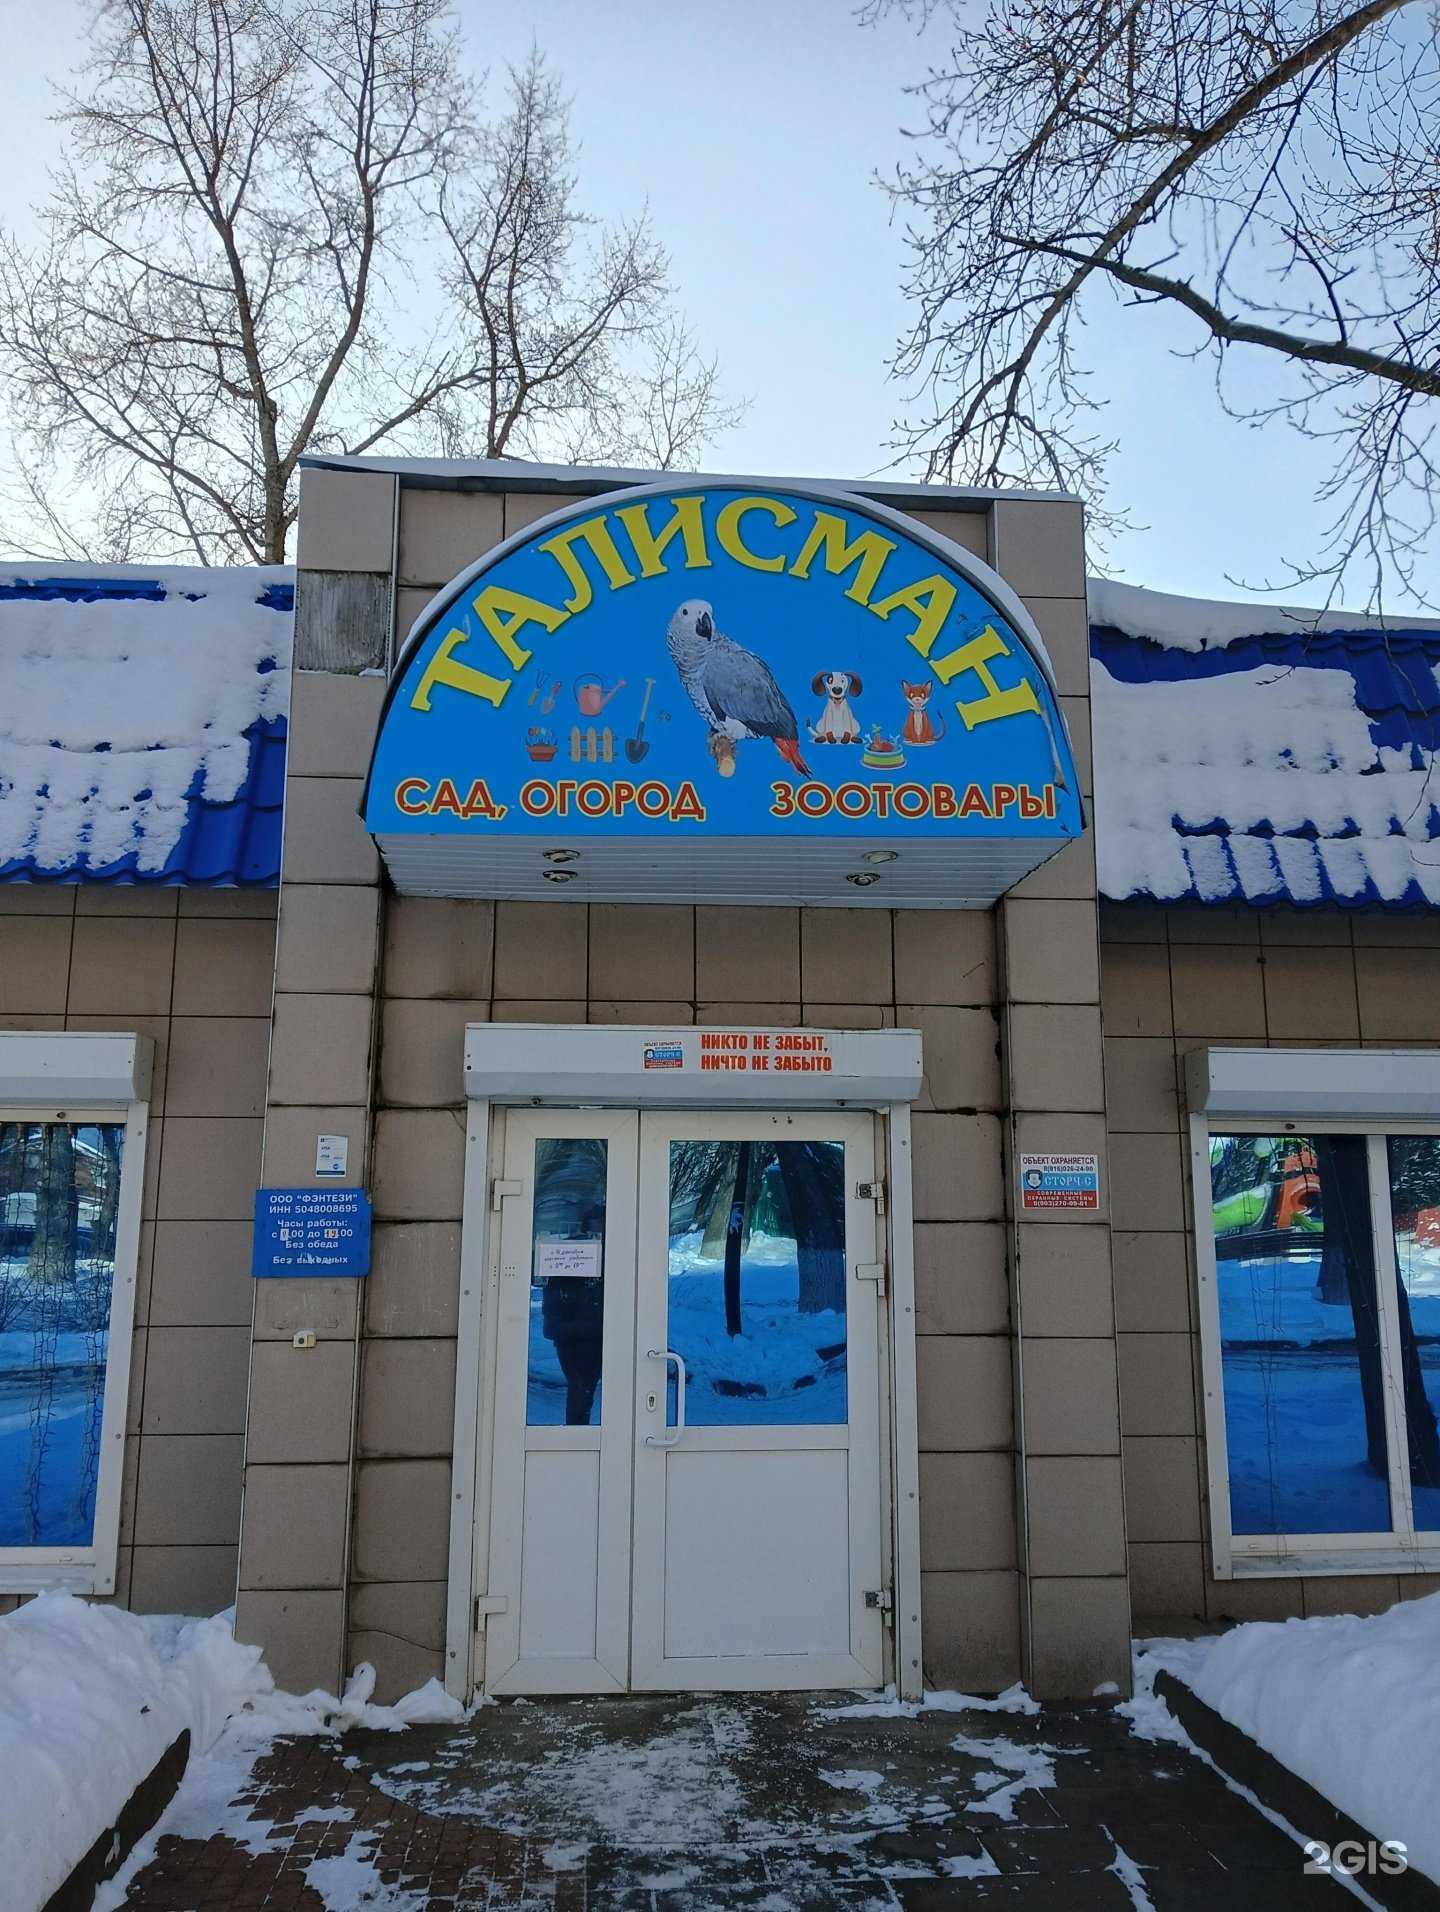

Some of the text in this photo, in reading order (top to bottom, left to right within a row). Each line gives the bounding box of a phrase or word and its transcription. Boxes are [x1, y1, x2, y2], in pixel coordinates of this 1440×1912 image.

[410, 496, 1041, 732] ТАЛИСМАН
[395, 779, 705, 820] САД, ОГОРОД
[771, 781, 1056, 819] ЗООТОВАРЫ
[701, 1034, 748, 1050] НИКТО
[753, 1035, 770, 1050] НЕ
[775, 1035, 829, 1053] ЗАБЫТ,
[701, 1055, 747, 1070] НИЧТО
[752, 1055, 769, 1071] НЕ
[774, 1055, 832, 1072] ЗАБЫТО
[1022, 1156, 1095, 1164] ОБЪЕКТ ОХРАНЯЕТСЯ
[270, 1193, 358, 1204] ООО "ФЭНТЕЗИ"
[269, 1204, 358, 1214] ИНН 5048008695
[277, 1218, 348, 1230] Часы работы:
[307, 1231, 321, 1239] до
[285, 1239, 339, 1249] Без обеда
[273, 1255, 292, 1265] Без
